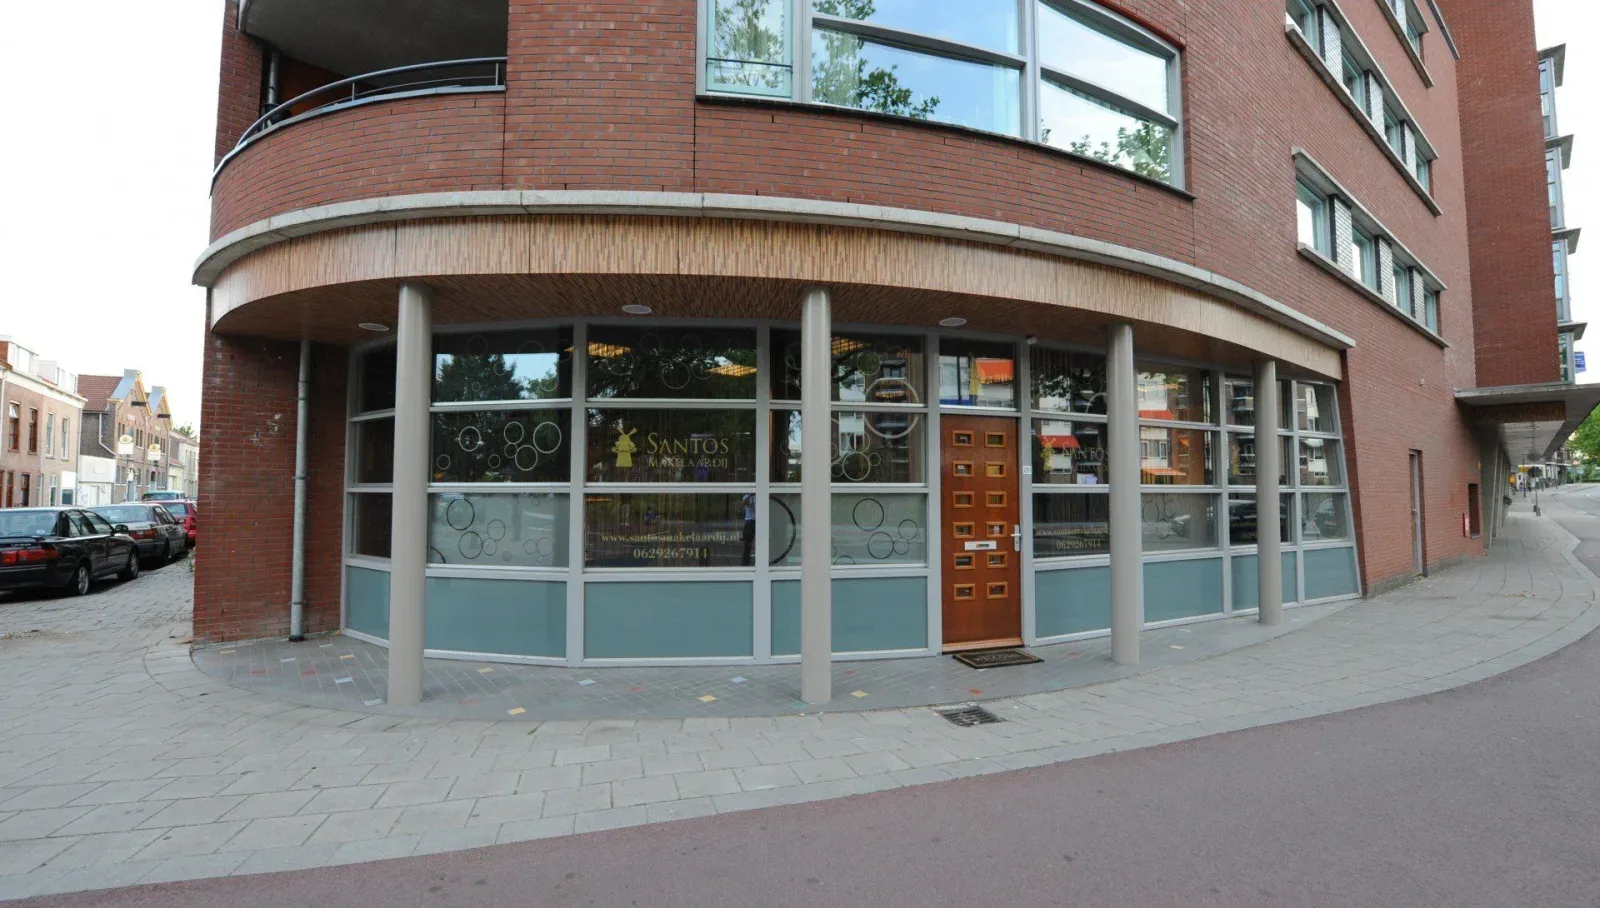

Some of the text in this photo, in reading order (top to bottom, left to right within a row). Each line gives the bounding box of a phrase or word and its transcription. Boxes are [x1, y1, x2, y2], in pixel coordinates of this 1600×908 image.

[647, 432, 729, 455] SANTOS
[647, 457, 728, 470] MAKELAARDIJ
[602, 531, 741, 544] www.santosmakelaardij.nl
[633, 547, 709, 559] 0629267914
